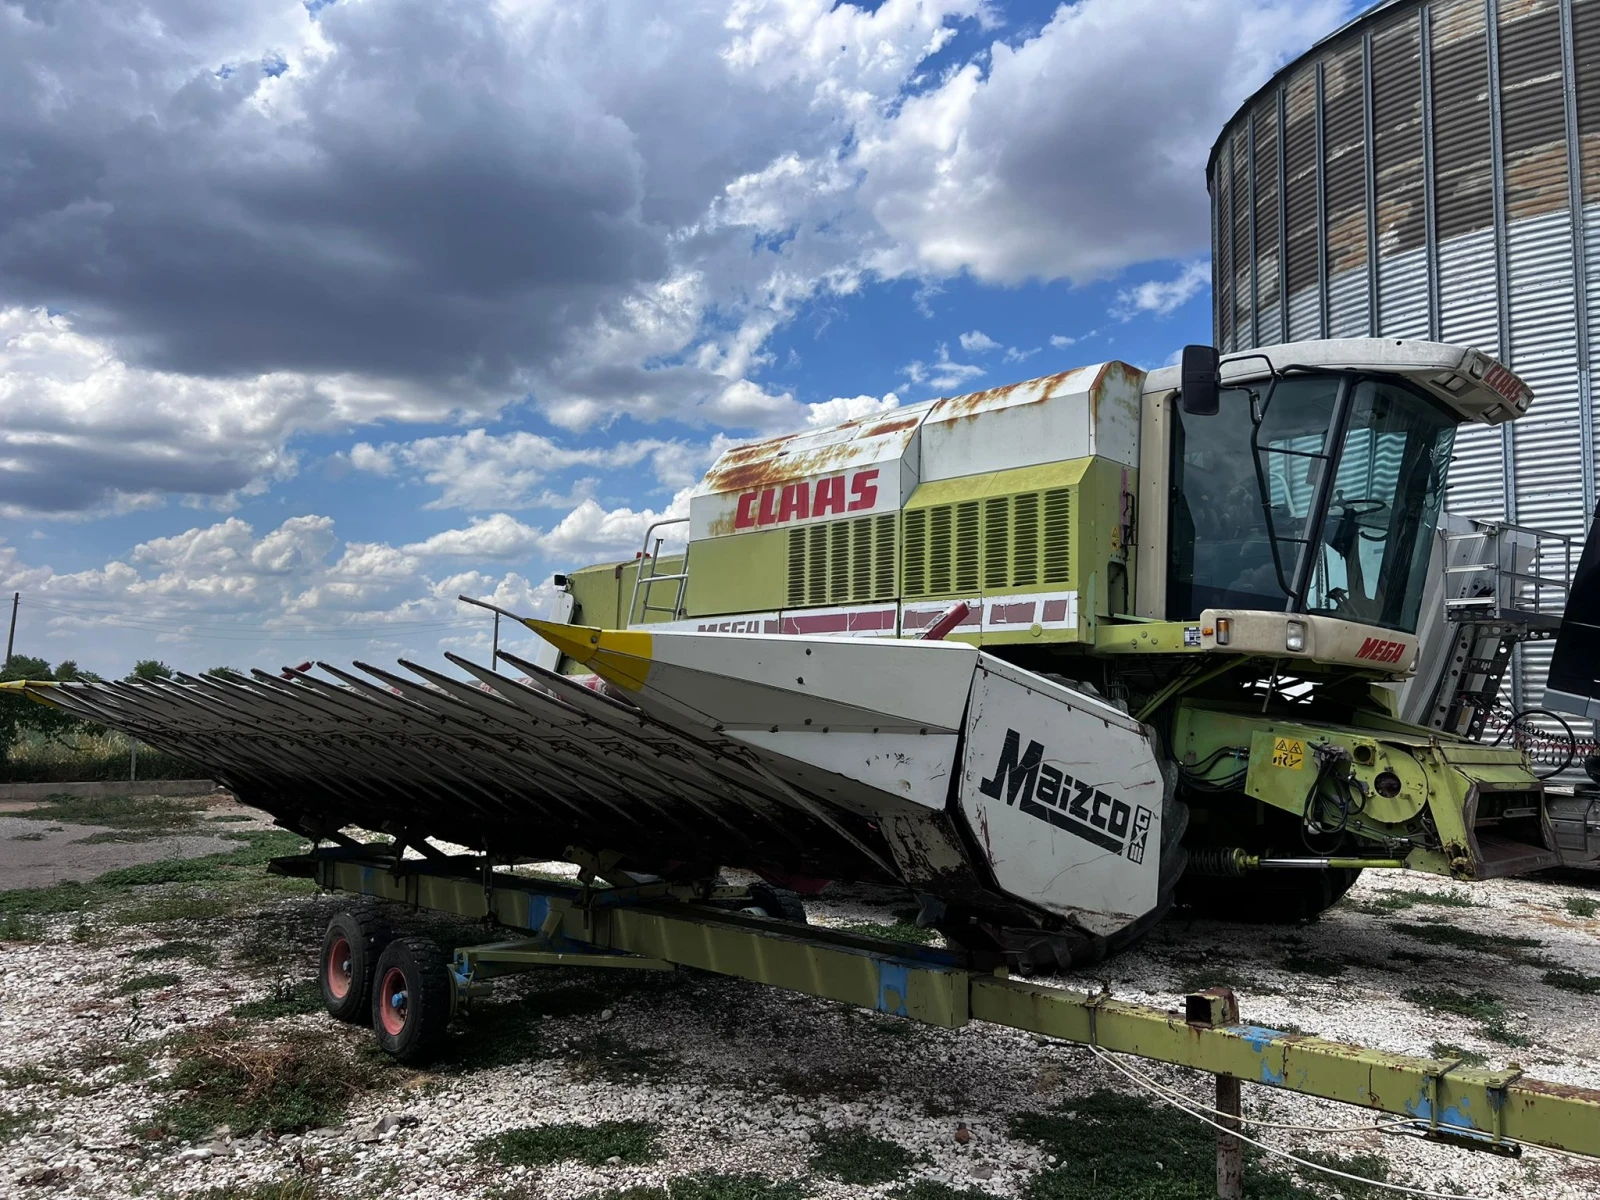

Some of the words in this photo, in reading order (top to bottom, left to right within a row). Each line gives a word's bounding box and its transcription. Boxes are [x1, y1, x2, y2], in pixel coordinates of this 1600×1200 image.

[1483, 363, 1525, 404] CLAAS
[735, 469, 879, 529] CLAAS
[1354, 637, 1406, 663] MEGA
[979, 728, 1131, 850] Maizco
